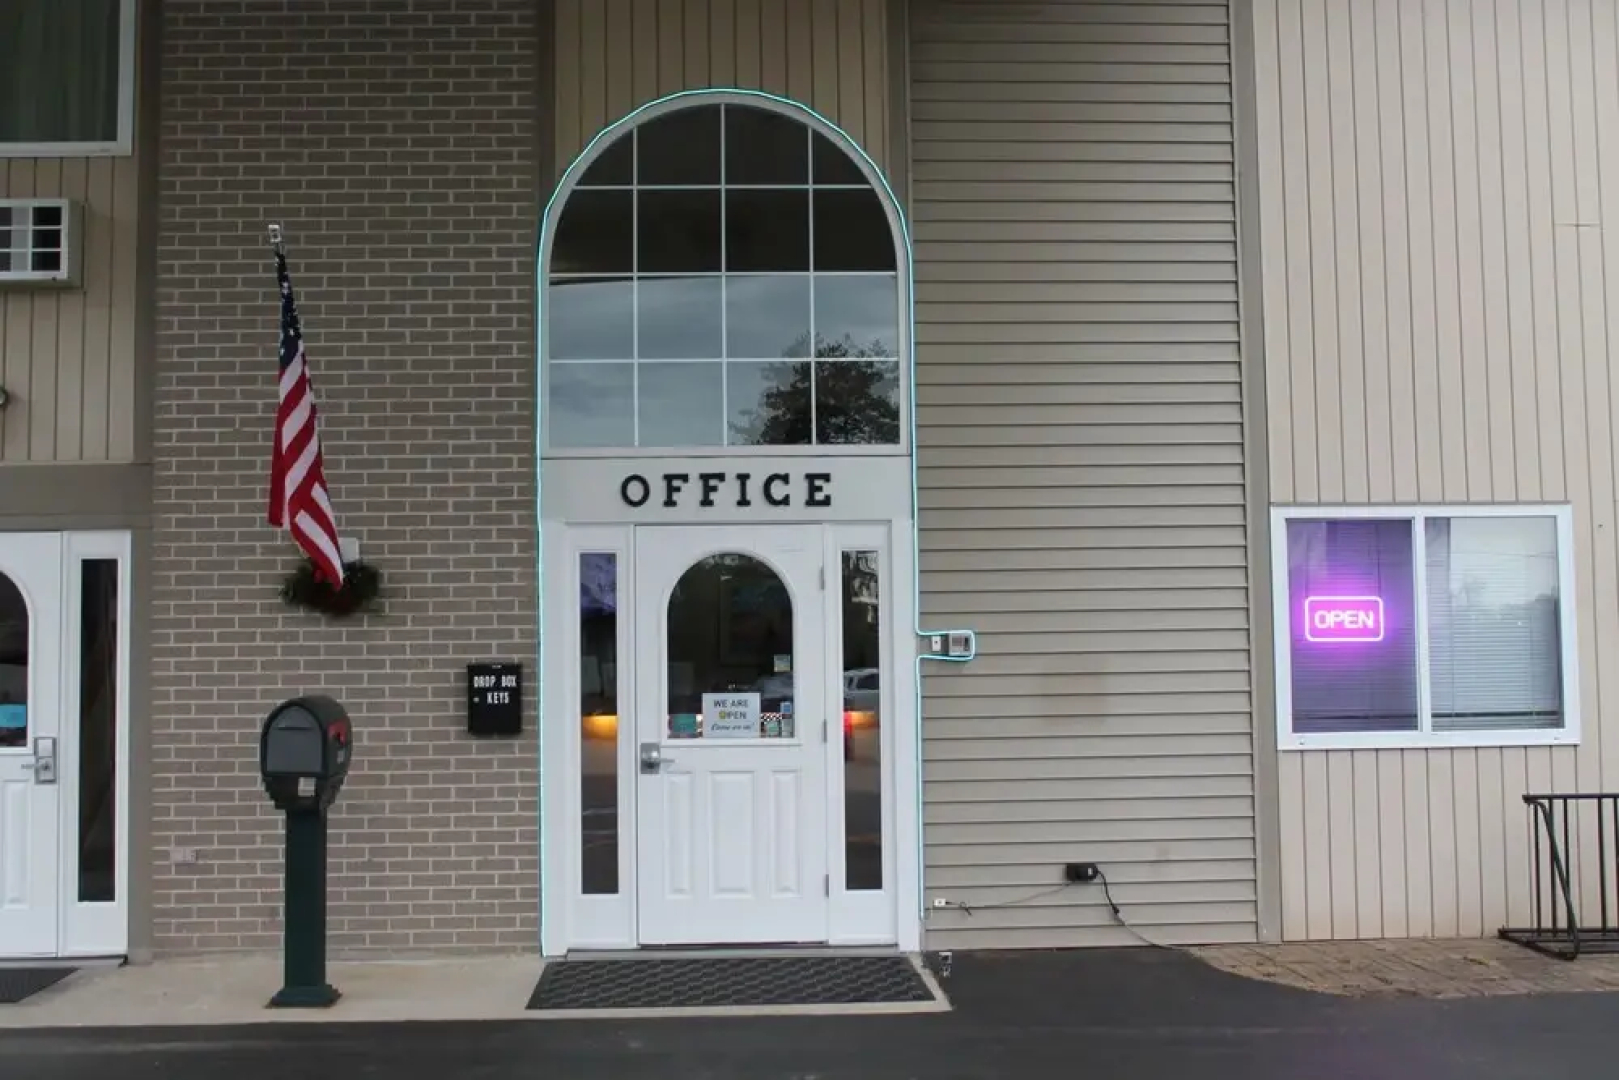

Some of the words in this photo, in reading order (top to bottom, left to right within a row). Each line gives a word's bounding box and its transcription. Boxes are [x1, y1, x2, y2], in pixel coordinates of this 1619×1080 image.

[620, 473, 832, 507] OFFICE
[1313, 609, 1375, 629] OPEN
[473, 675, 496, 688] DROP
[501, 675, 517, 688] BOX
[486, 691, 510, 704] KEYS
[713, 699, 728, 708] WE
[731, 699, 749, 708] ARE
[718, 710, 747, 720] OPEN
